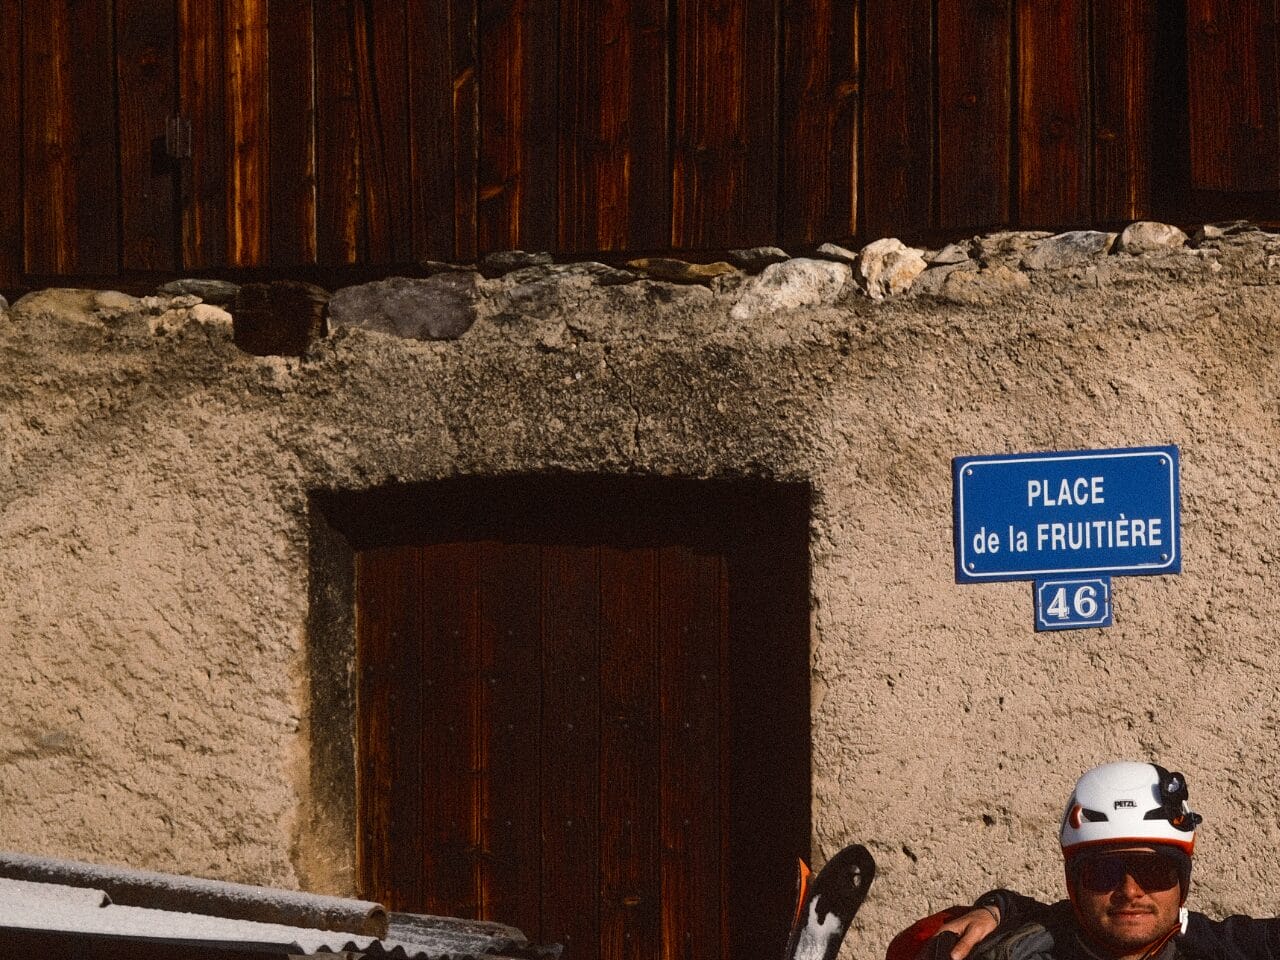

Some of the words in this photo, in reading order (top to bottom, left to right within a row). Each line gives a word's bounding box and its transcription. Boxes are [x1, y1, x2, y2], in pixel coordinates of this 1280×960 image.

[1028, 477, 1105, 507] PLACE
[973, 527, 999, 554] de
[1009, 525, 1028, 552] la
[1037, 513, 1162, 551] FRUITIÈRE
[1046, 586, 1098, 619] 46
[1113, 800, 1138, 810] PETZL
